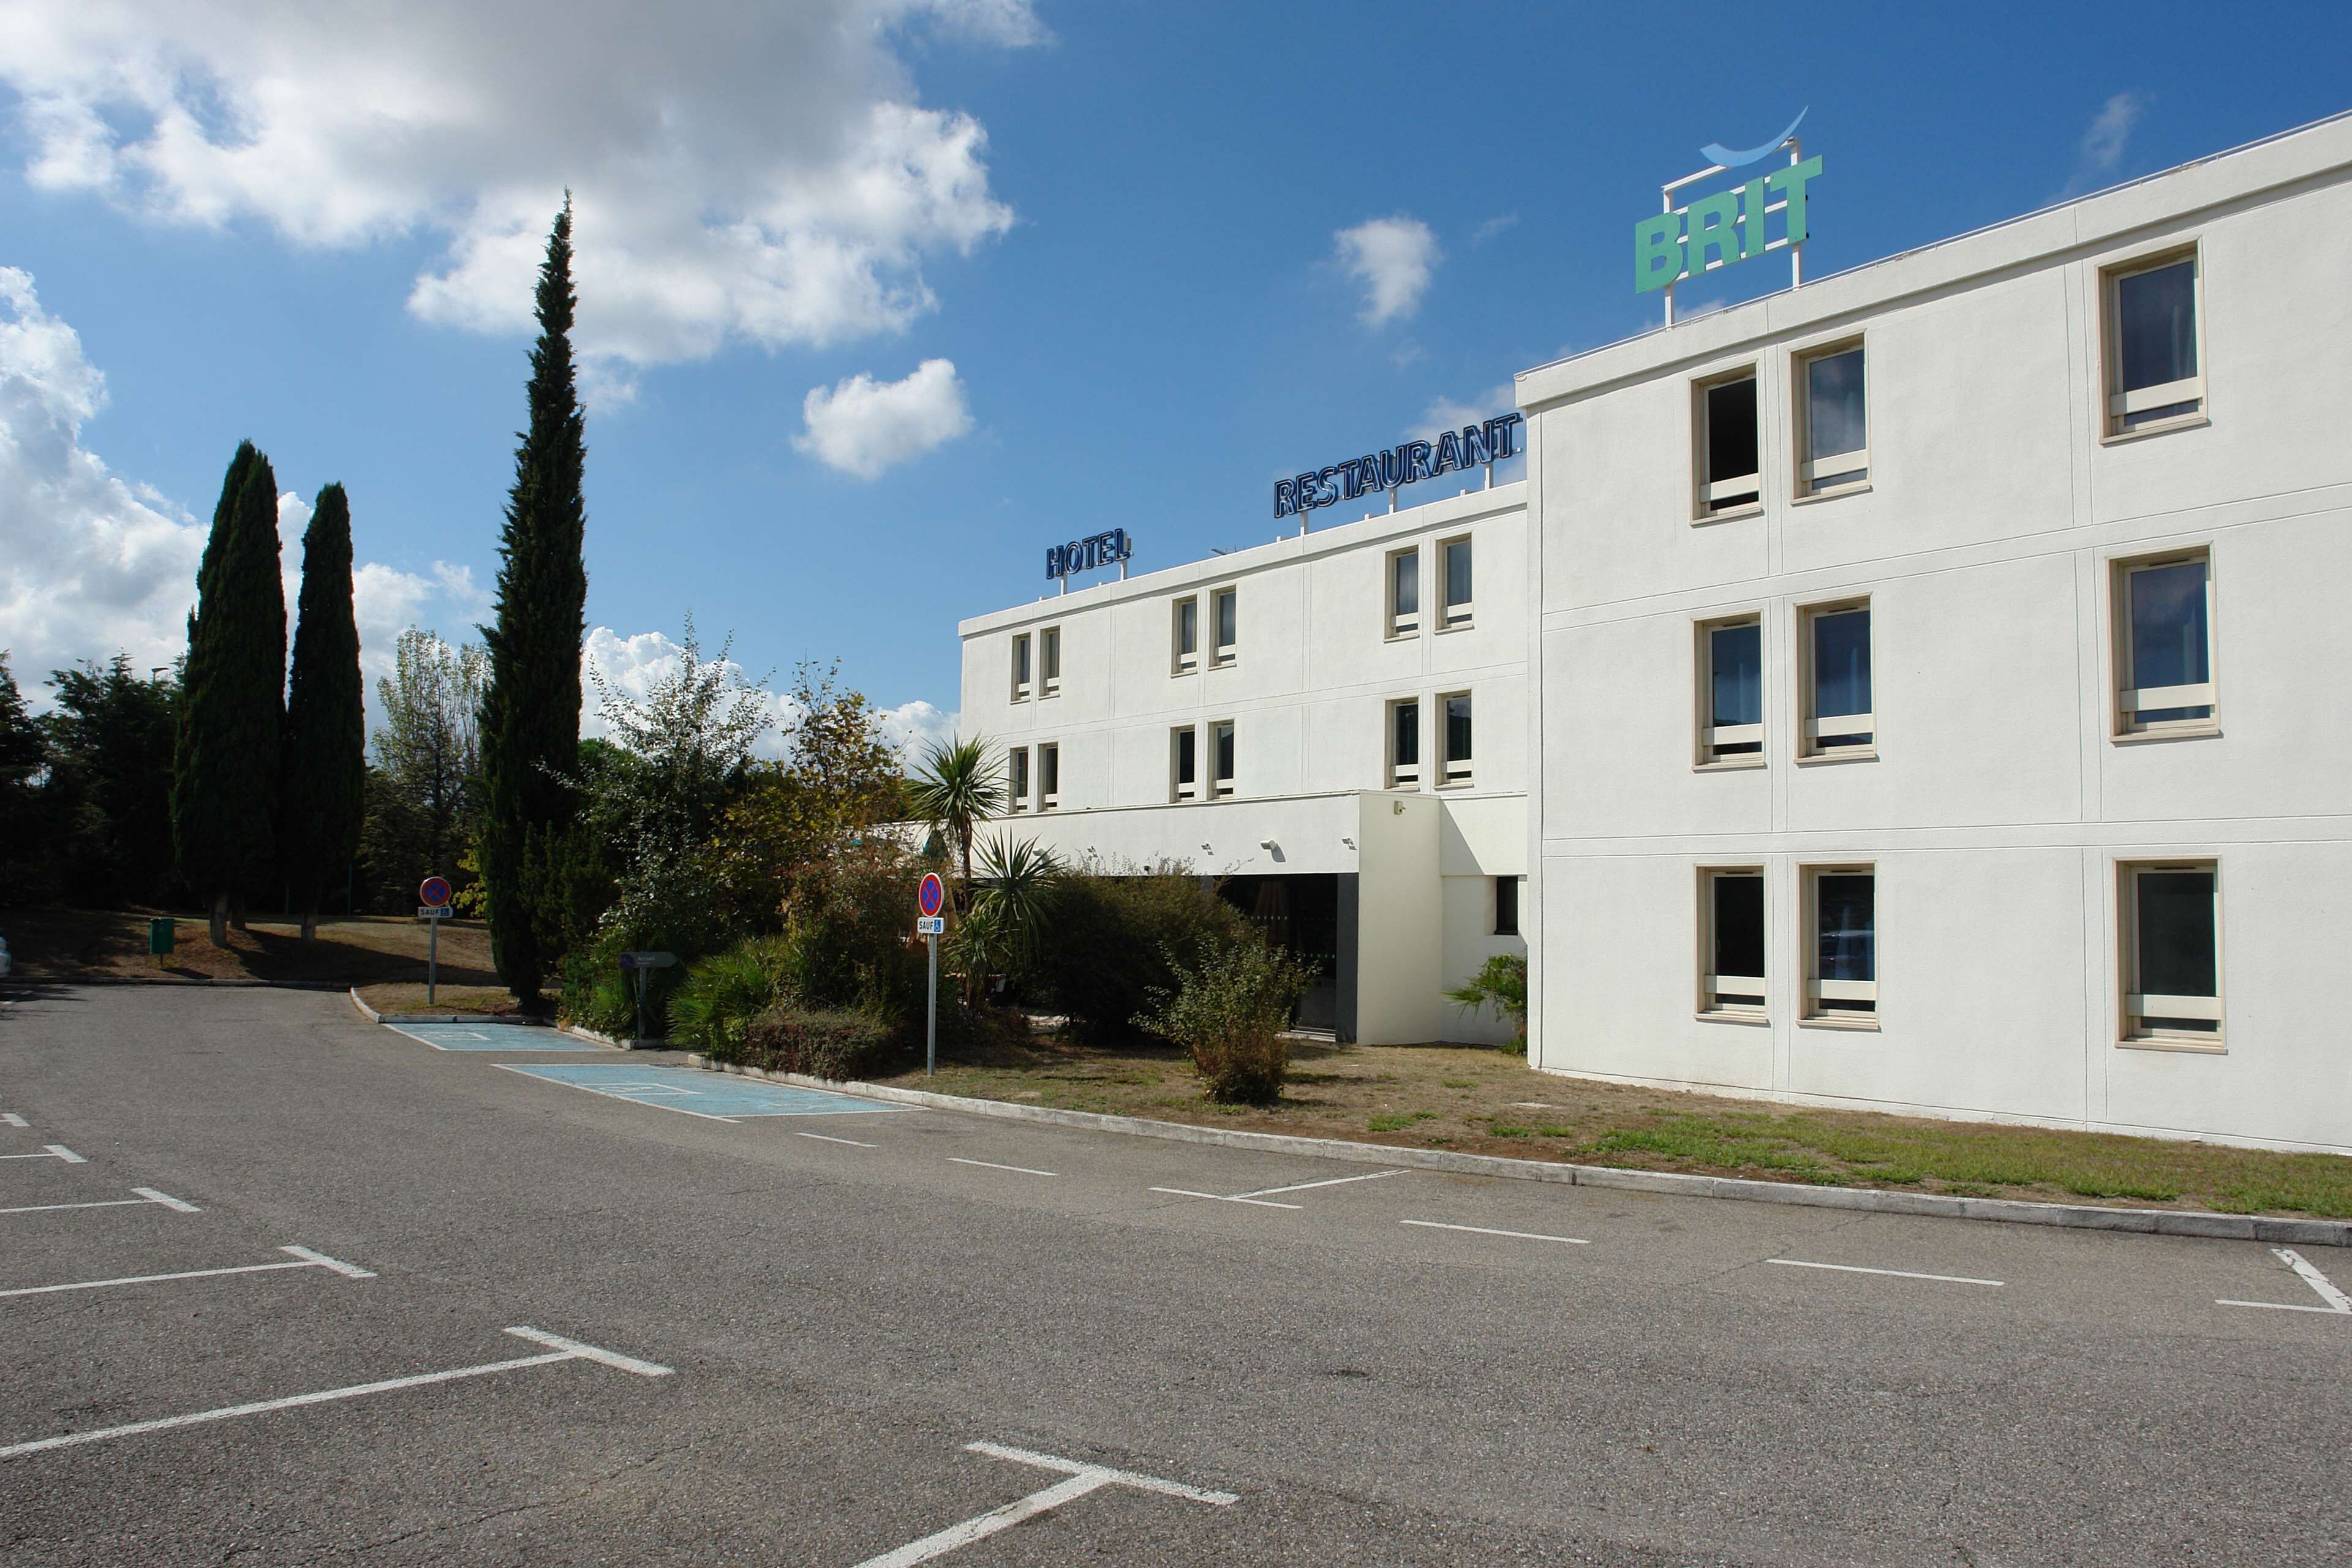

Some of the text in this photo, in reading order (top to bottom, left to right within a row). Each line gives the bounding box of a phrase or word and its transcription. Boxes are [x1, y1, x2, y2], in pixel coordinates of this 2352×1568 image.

[1635, 154, 1822, 293] BRIT
[1274, 413, 1523, 519] RESTAURANT
[1046, 528, 1131, 580] HOTEL
[919, 921, 933, 930] SAUF
